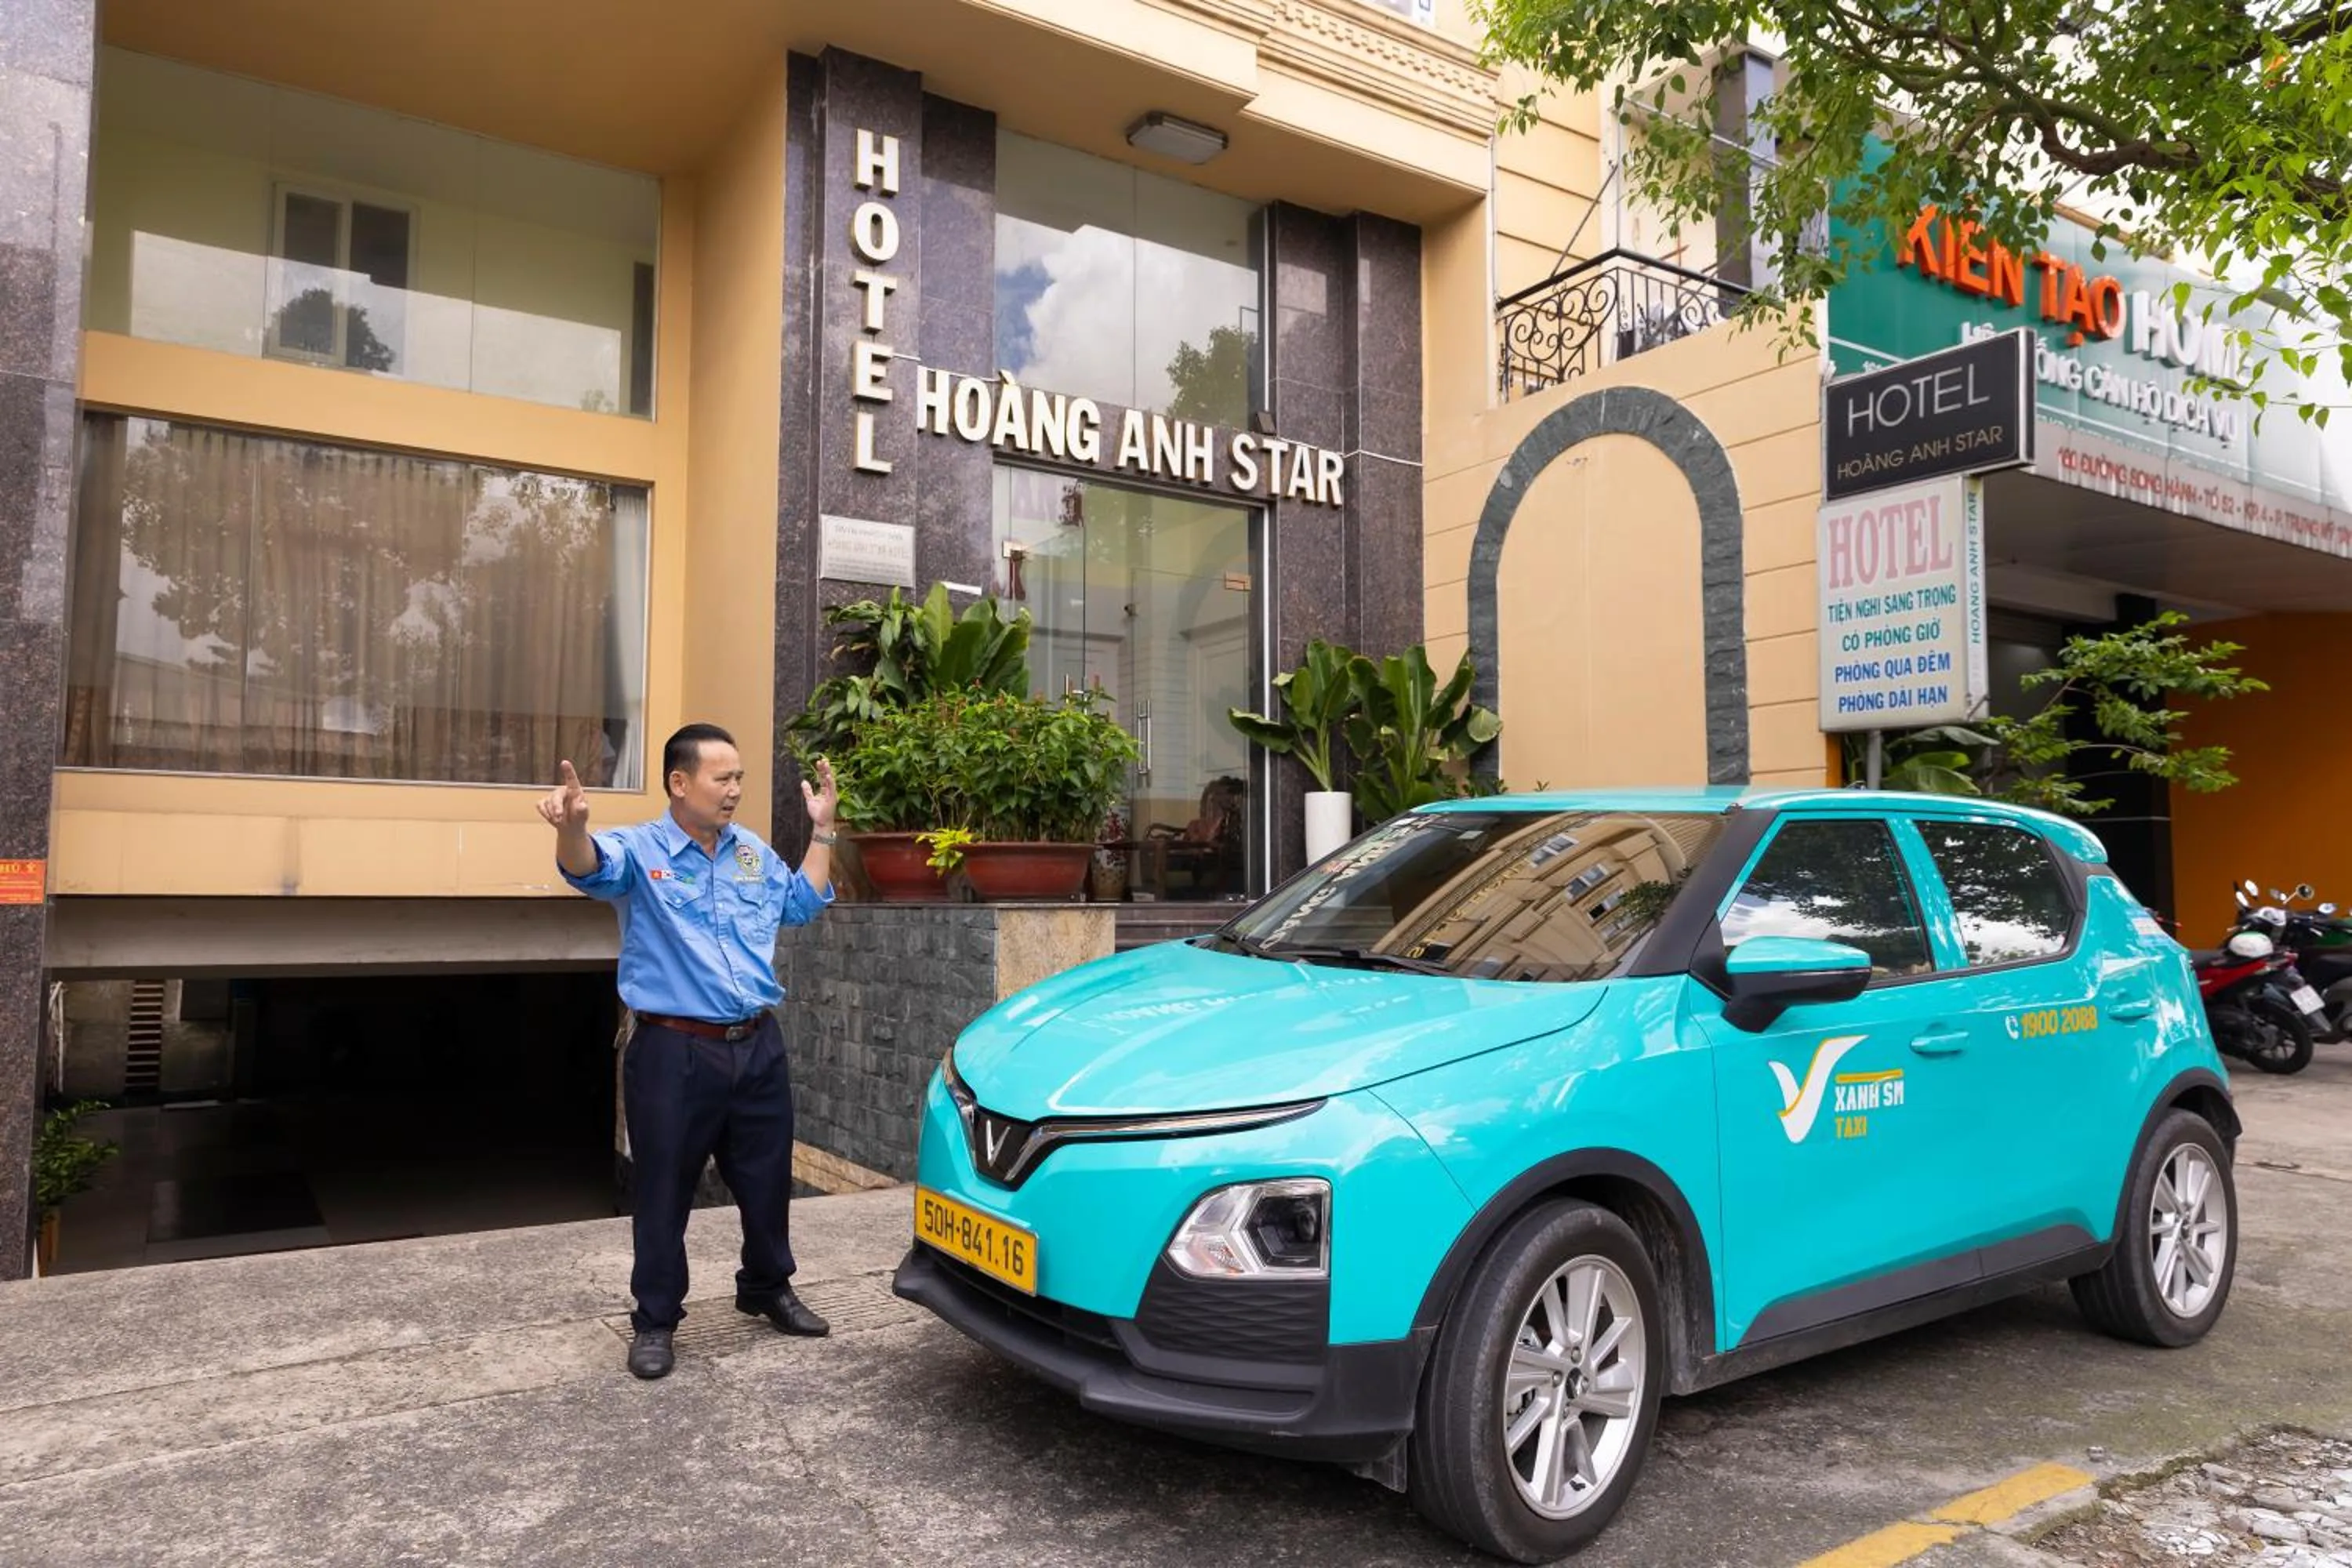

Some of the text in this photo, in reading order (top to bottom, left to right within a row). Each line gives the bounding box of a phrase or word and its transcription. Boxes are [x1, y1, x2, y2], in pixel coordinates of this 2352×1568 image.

[853, 129, 899, 474] HOTEL
[2033, 249, 2127, 347] TẠO
[2034, 336, 2084, 391] ỐNG
[1848, 363, 1991, 437] HOTEL
[916, 365, 1345, 506] HOÀNG ANH STAR
[1837, 425, 2003, 481] HOÀNG ANH STAR
[1828, 495, 1952, 590] HOTEL
[1856, 598, 1881, 619] NGHI
[1885, 591, 1913, 614] SANG
[1916, 584, 1956, 610] TRỌNG
[1842, 630, 1860, 652] CÓ
[1864, 625, 1911, 648] PHÒNG
[1835, 660, 1881, 684] PHÒNG
[1885, 658, 1913, 680] QUA
[1917, 650, 1951, 673] ĐÊM
[1838, 685, 1947, 713] PHÒNG DÀI HẠN
[2022, 1010, 2058, 1038] 1900
[1835, 1080, 1904, 1112] XANH SM
[1835, 1116, 1867, 1139] TAXI
[924, 1199, 1025, 1276] 50H-841.16
